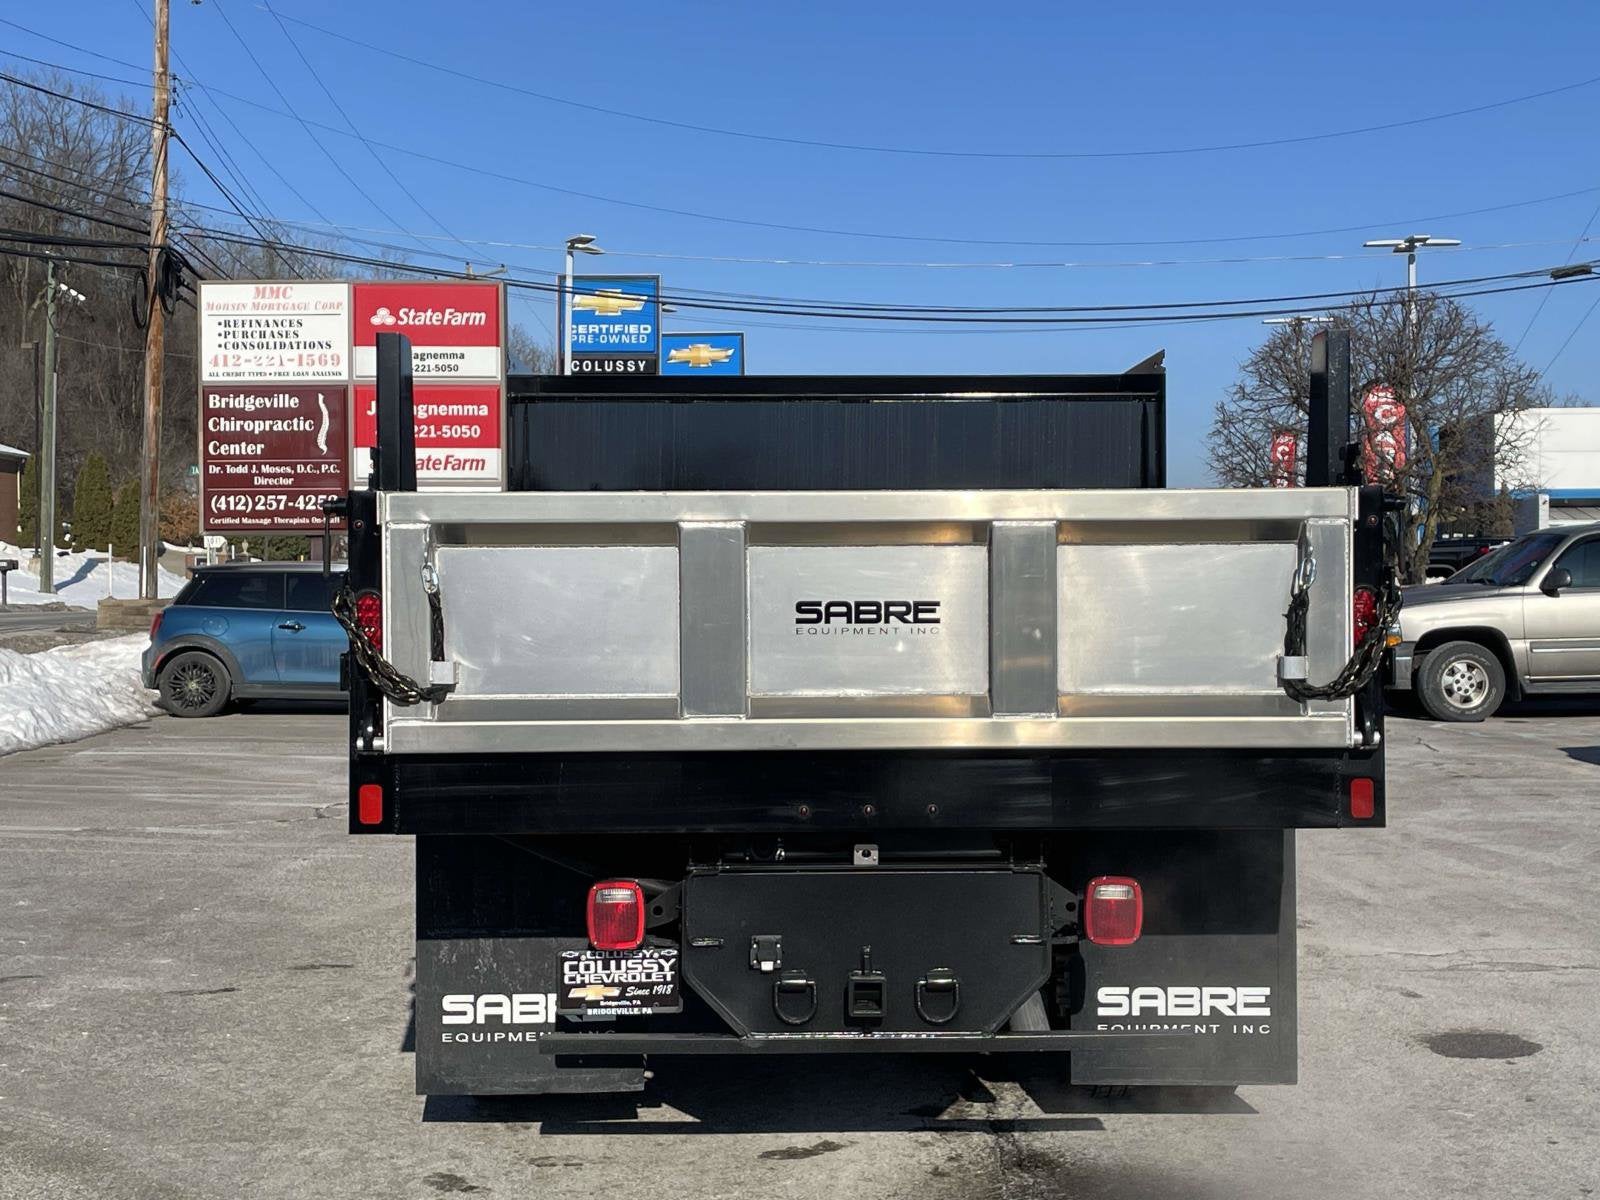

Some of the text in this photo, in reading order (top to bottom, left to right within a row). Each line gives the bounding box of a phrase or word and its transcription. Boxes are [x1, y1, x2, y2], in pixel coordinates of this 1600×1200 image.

[253, 286, 293, 299] MMC
[251, 302, 310, 311] MORTGAGE
[224, 319, 303, 328] REFINANCES
[224, 330, 299, 339] PURCHASES
[224, 341, 332, 350] CONSOLIDATIONS
[209, 353, 341, 368] 412-221-1569
[413, 352, 465, 361] agnemma
[412, 364, 459, 373] 221-5050
[571, 360, 646, 372] COLUSSY
[208, 394, 300, 412] Bridgeville
[208, 417, 314, 434] Chiropractic
[208, 441, 265, 455] Center
[415, 455, 486, 471] ateFarm
[208, 465, 223, 474] Dr.
[226, 465, 248, 474] Todd
[251, 465, 259, 474] J.
[261, 465, 294, 475] Moses,
[321, 464, 340, 473] P.C.
[254, 476, 294, 485] Director
[211, 495, 253, 513] (412)
[210, 516, 340, 525] Certified Massage Therapists On-aff
[795, 601, 941, 624] SABRE
[795, 627, 940, 635] EQUIPMENT INC
[564, 958, 676, 974] COLUSSY
[564, 971, 675, 984] CHEVROLET
[625, 984, 674, 997] Since 1918
[1097, 986, 1271, 1017] SABRE
[442, 993, 557, 1025] SAB
[642, 1007, 653, 1015] PA
[1232, 1024, 1271, 1034] INC
[442, 1031, 551, 1043] EQUIPME
